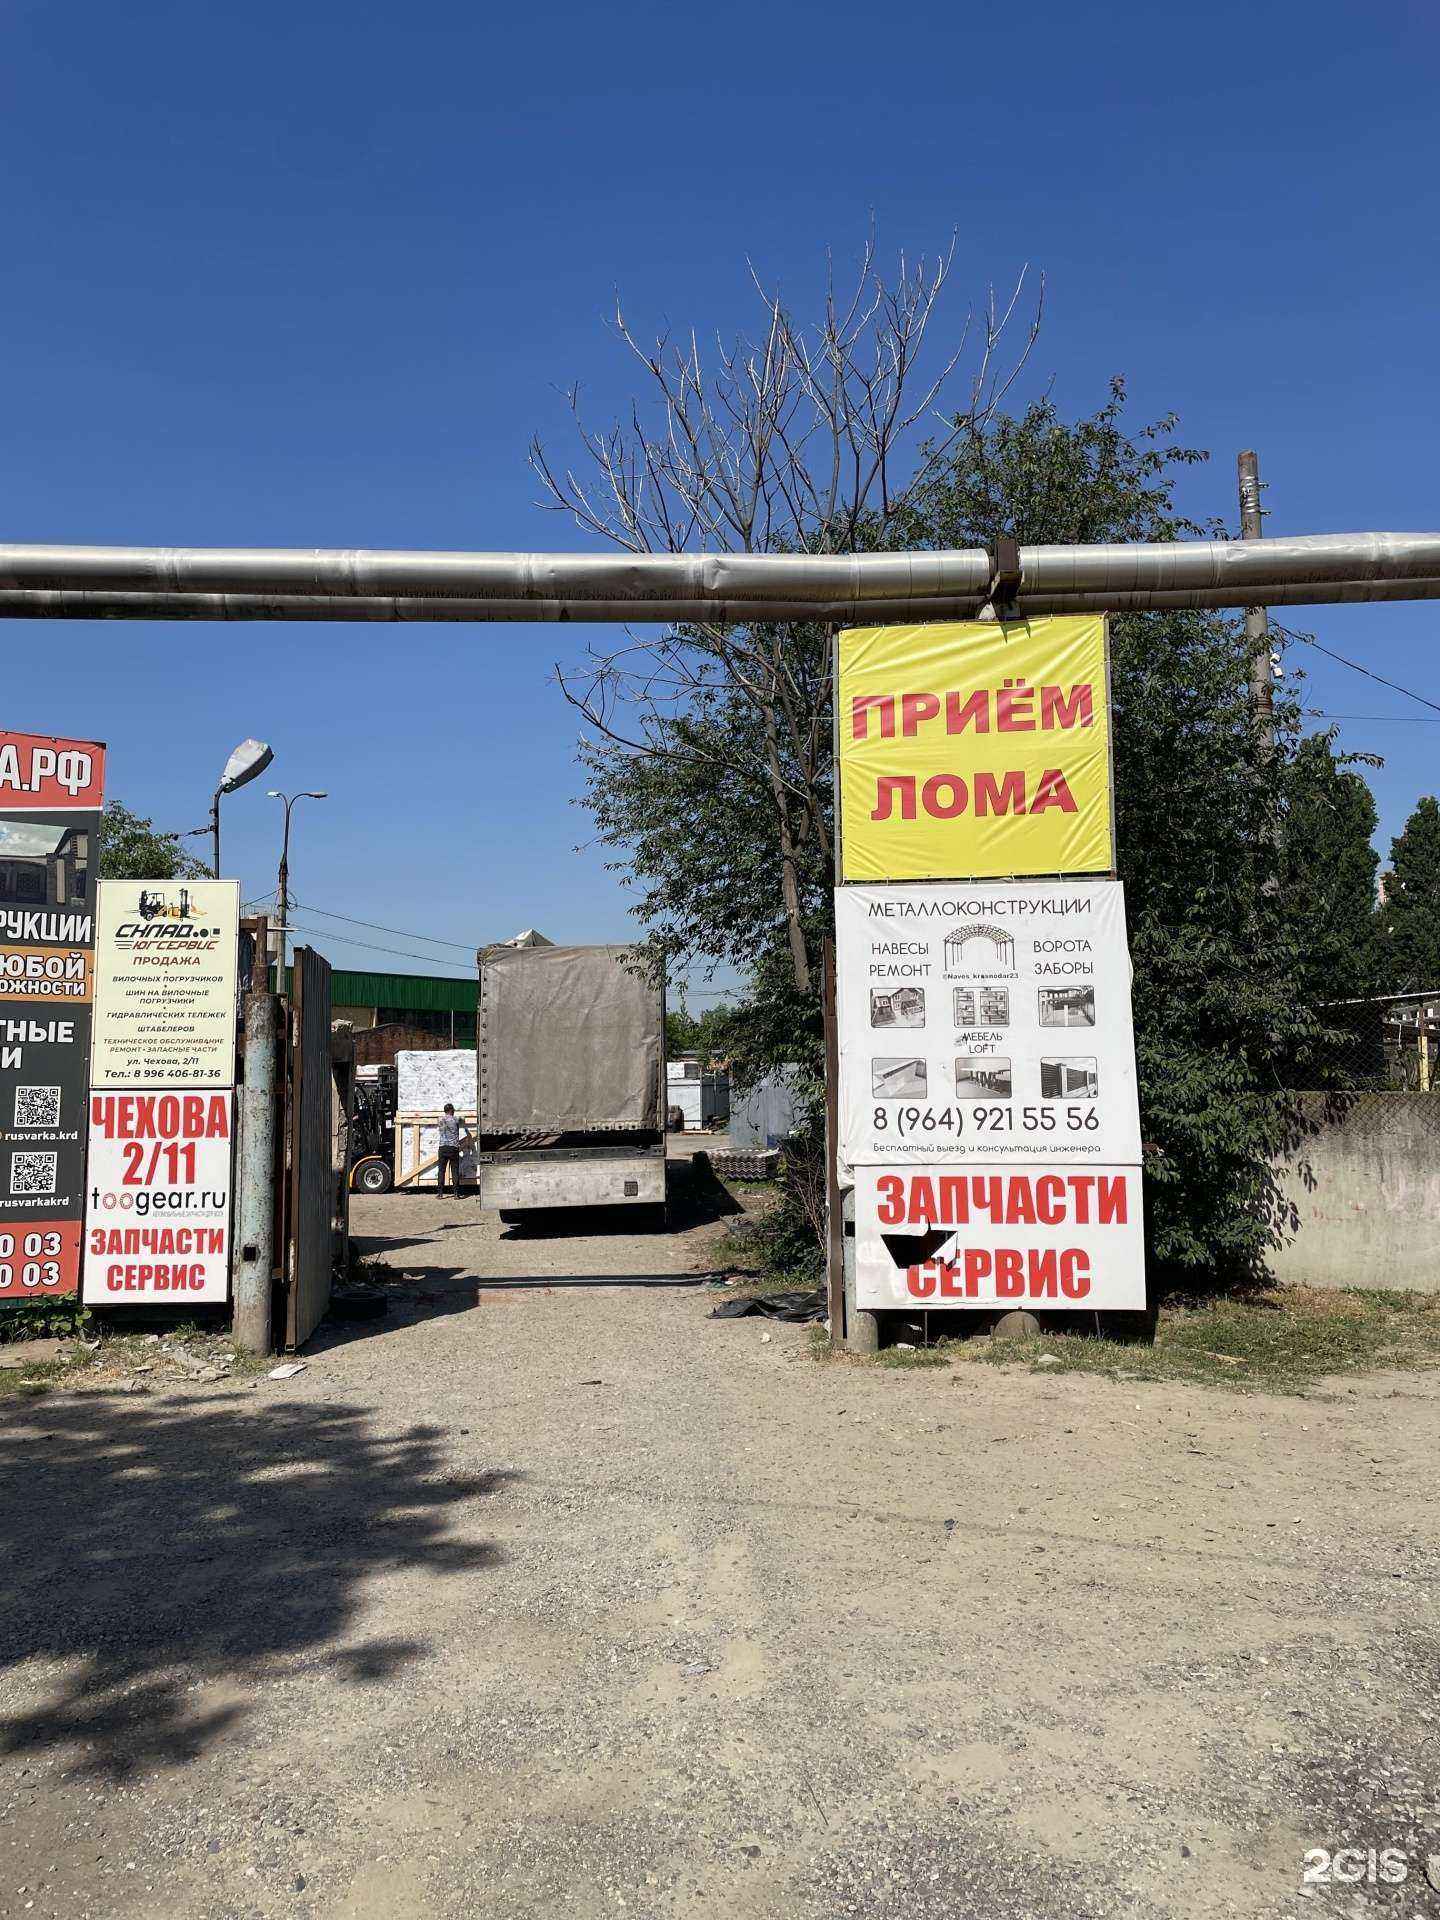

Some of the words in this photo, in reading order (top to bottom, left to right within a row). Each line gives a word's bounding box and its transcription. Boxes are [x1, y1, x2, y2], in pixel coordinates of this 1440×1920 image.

[852, 679, 1093, 739] ПРИЁМ
[870, 769, 1078, 821] ЛОМА
[868, 899, 1091, 917] МЕТАЛЛОКОНСТРУКЦИИ
[871, 942, 929, 955] НАВЕСЫ
[1033, 940, 1092, 953] ВОРОТА
[133, 956, 201, 967] ПРОДАЖА
[1034, 962, 1093, 975] ЗАБОРЫ
[869, 964, 932, 977] РЕМОНТ
[106, 1011, 185, 1019] ГИДРАВЛИЧЕСКИХ
[187, 1011, 226, 1019] ТЕЛЕЖЕК
[961, 1032, 1003, 1042] МЕБЕЛЬ
[968, 1044, 996, 1053] LOFT
[126, 1059, 141, 1067] ул.
[144, 1058, 180, 1066] Чехова,
[104, 1069, 131, 1078] Тел.:
[133, 1069, 141, 1078] 8
[143, 1069, 165, 1078] 996
[166, 1069, 221, 1078] 406-81-36
[91, 1095, 229, 1140] ЧЕХОВА
[873, 1107, 888, 1130] 8
[897, 1107, 963, 1137] (964)
[973, 1107, 1014, 1130] 921
[1022, 1107, 1056, 1130] 55
[1066, 1107, 1100, 1130] 56
[5, 1131, 78, 1141] rusvarka.krd
[873, 1143, 934, 1153] Бесплатный
[936, 1145, 966, 1154] выезд
[976, 1144, 1047, 1155] консультация
[1049, 1144, 1101, 1154] инженера
[122, 1142, 196, 1186] 2/11
[0, 1197, 70, 1208] rusvarkakrd
[91, 1187, 226, 1216] toogear.ru
[876, 1175, 1128, 1225] ЗАПЧАСТИ
[24, 1231, 62, 1258] 03
[90, 1228, 225, 1256] ЗАПЧАСТИ
[22, 1261, 60, 1287] 03
[106, 1263, 206, 1291] СЕРВИС
[906, 1248, 1091, 1299] СЕРВИС
